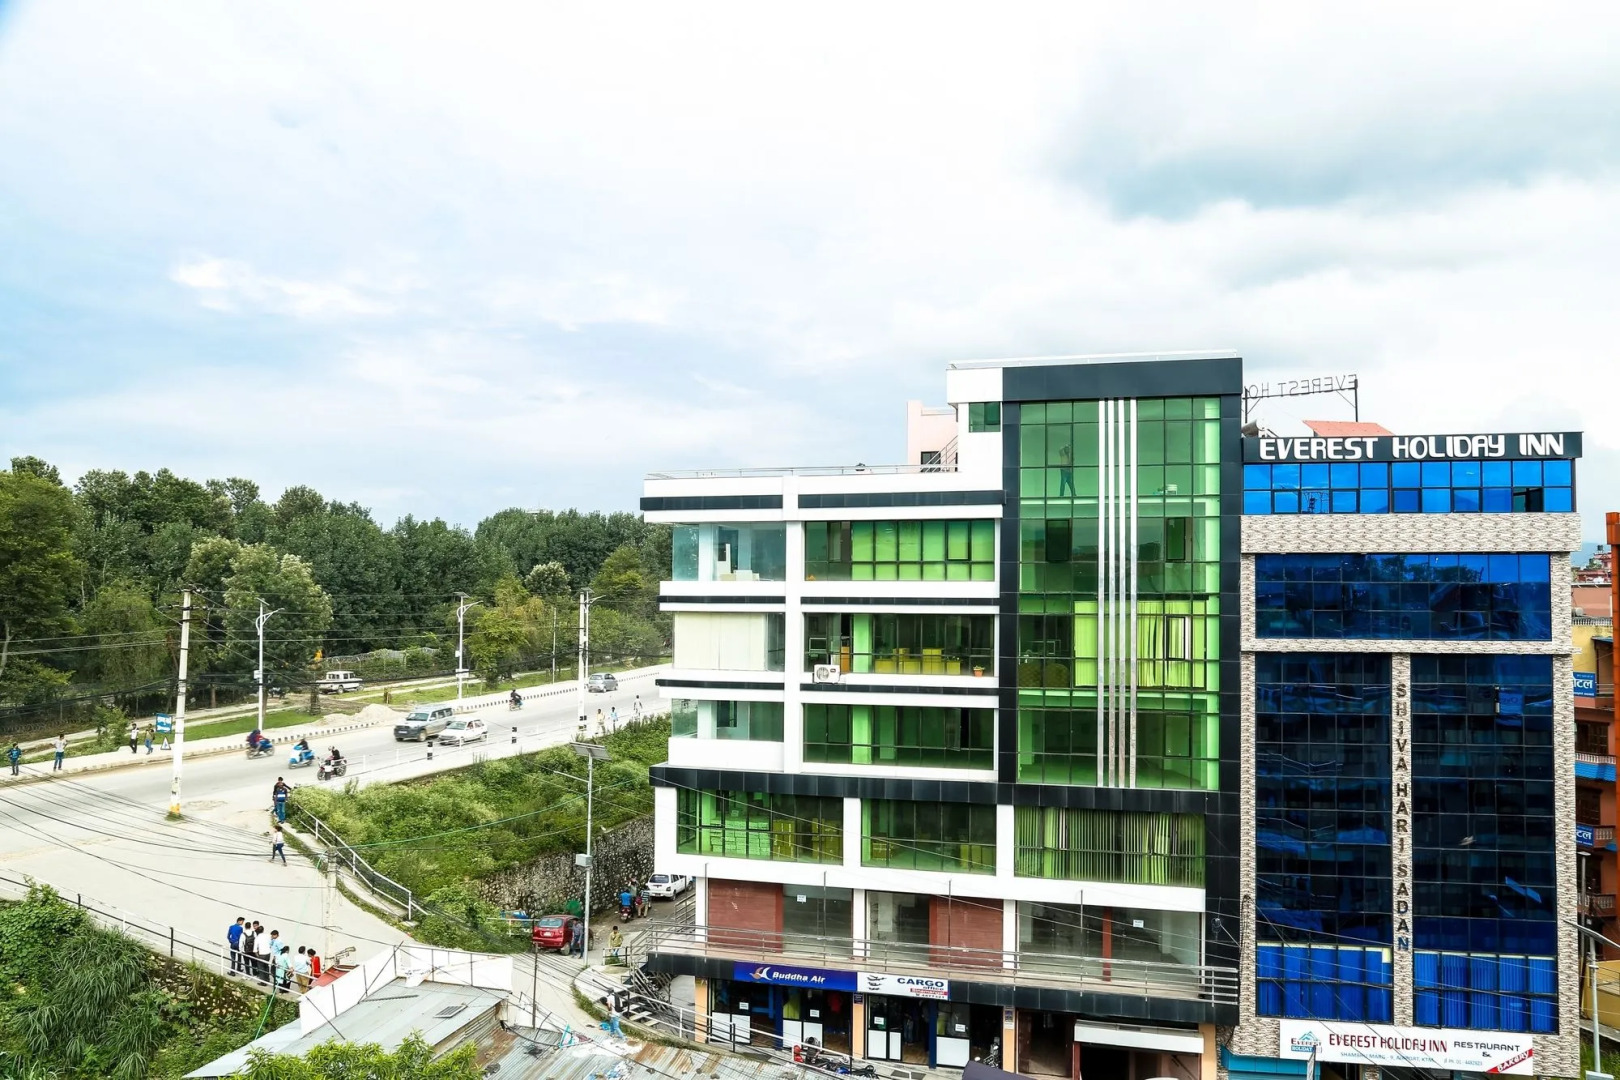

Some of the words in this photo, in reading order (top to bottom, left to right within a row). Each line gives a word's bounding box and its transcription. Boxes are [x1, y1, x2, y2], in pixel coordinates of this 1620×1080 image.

[1259, 437, 1379, 460] EVEREST
[1392, 434, 1505, 460] HOLIDAY
[1519, 433, 1564, 456] INN
[1395, 782, 1409, 853] HARI
[1396, 863, 1409, 951] SADAN
[772, 971, 809, 982] Buddha
[810, 975, 826, 984] Air
[897, 977, 945, 988] CARGO
[1329, 1033, 1377, 1048] EVEREST
[1380, 1036, 1426, 1052] HOLIDAY
[1429, 1039, 1447, 1053] INN
[1454, 1041, 1521, 1052] RESTAURANT
